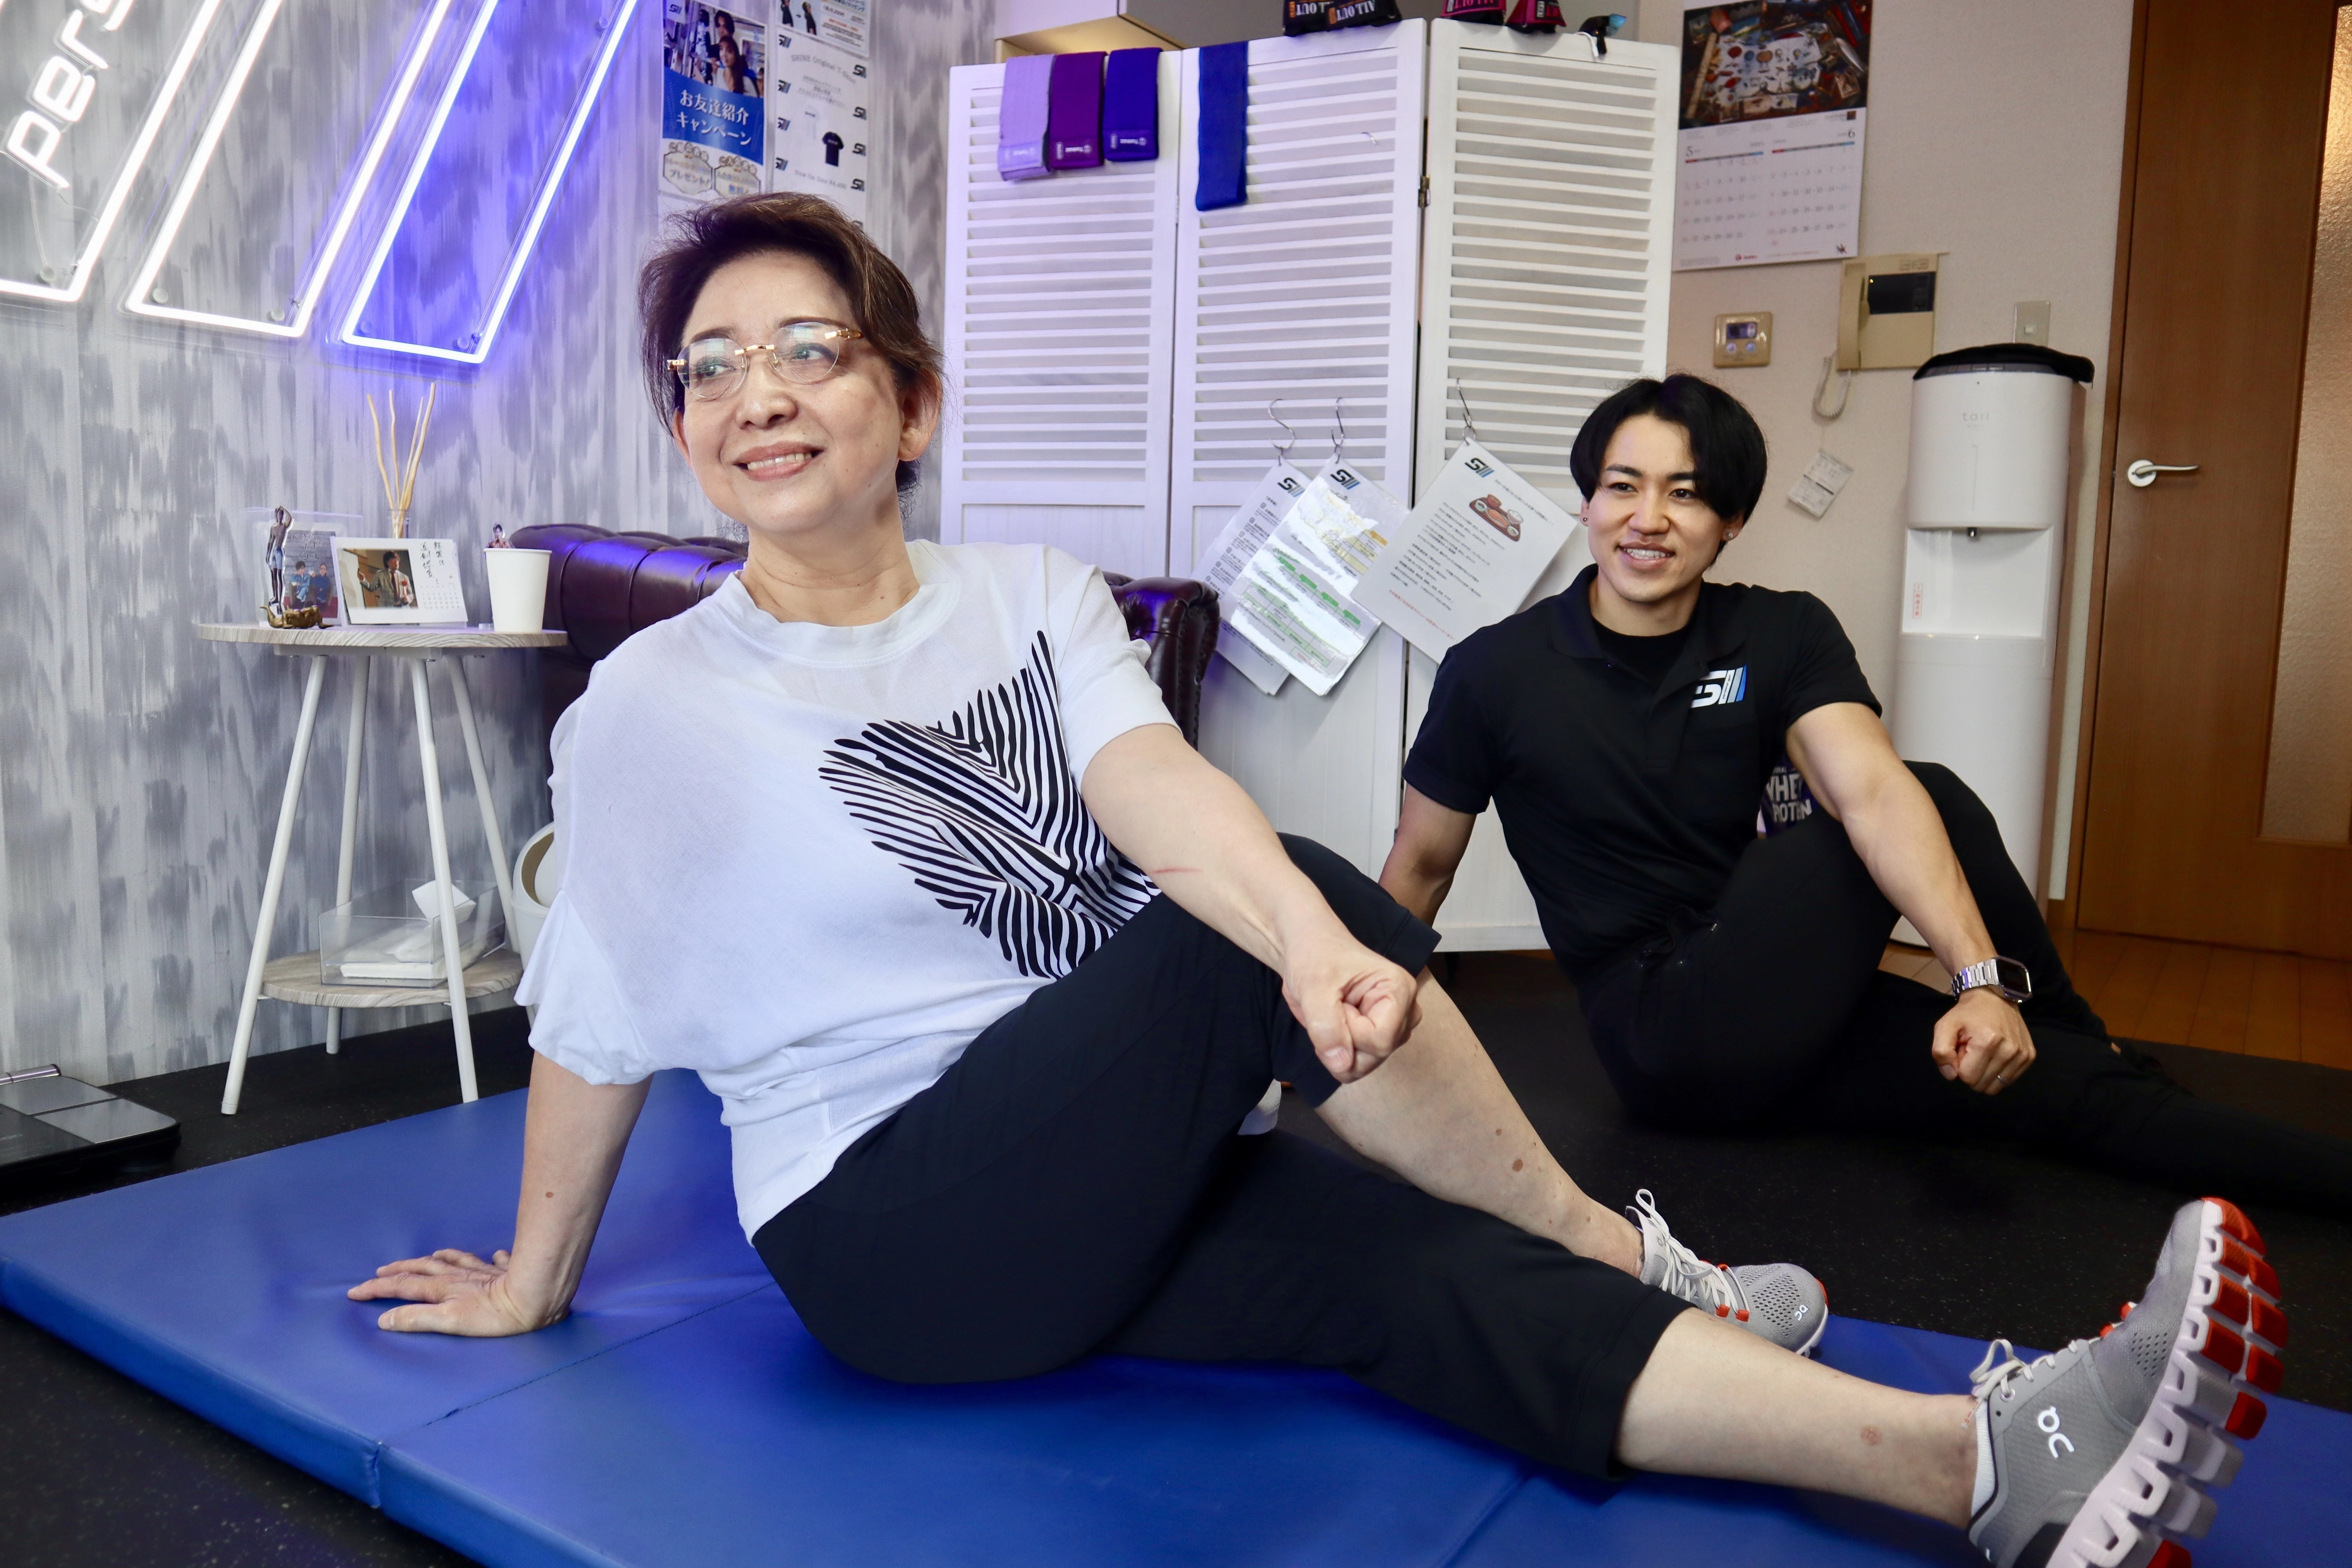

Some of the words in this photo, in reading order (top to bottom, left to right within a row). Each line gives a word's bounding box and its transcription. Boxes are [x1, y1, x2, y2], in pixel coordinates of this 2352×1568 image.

[1296, 3, 1318, 16] OUT
[1337, 5, 1355, 20] OUT
[1355, 1, 1376, 14] ALL
[680, 89, 749, 125] お友達紹介
[677, 111, 751, 145] キャンペーン
